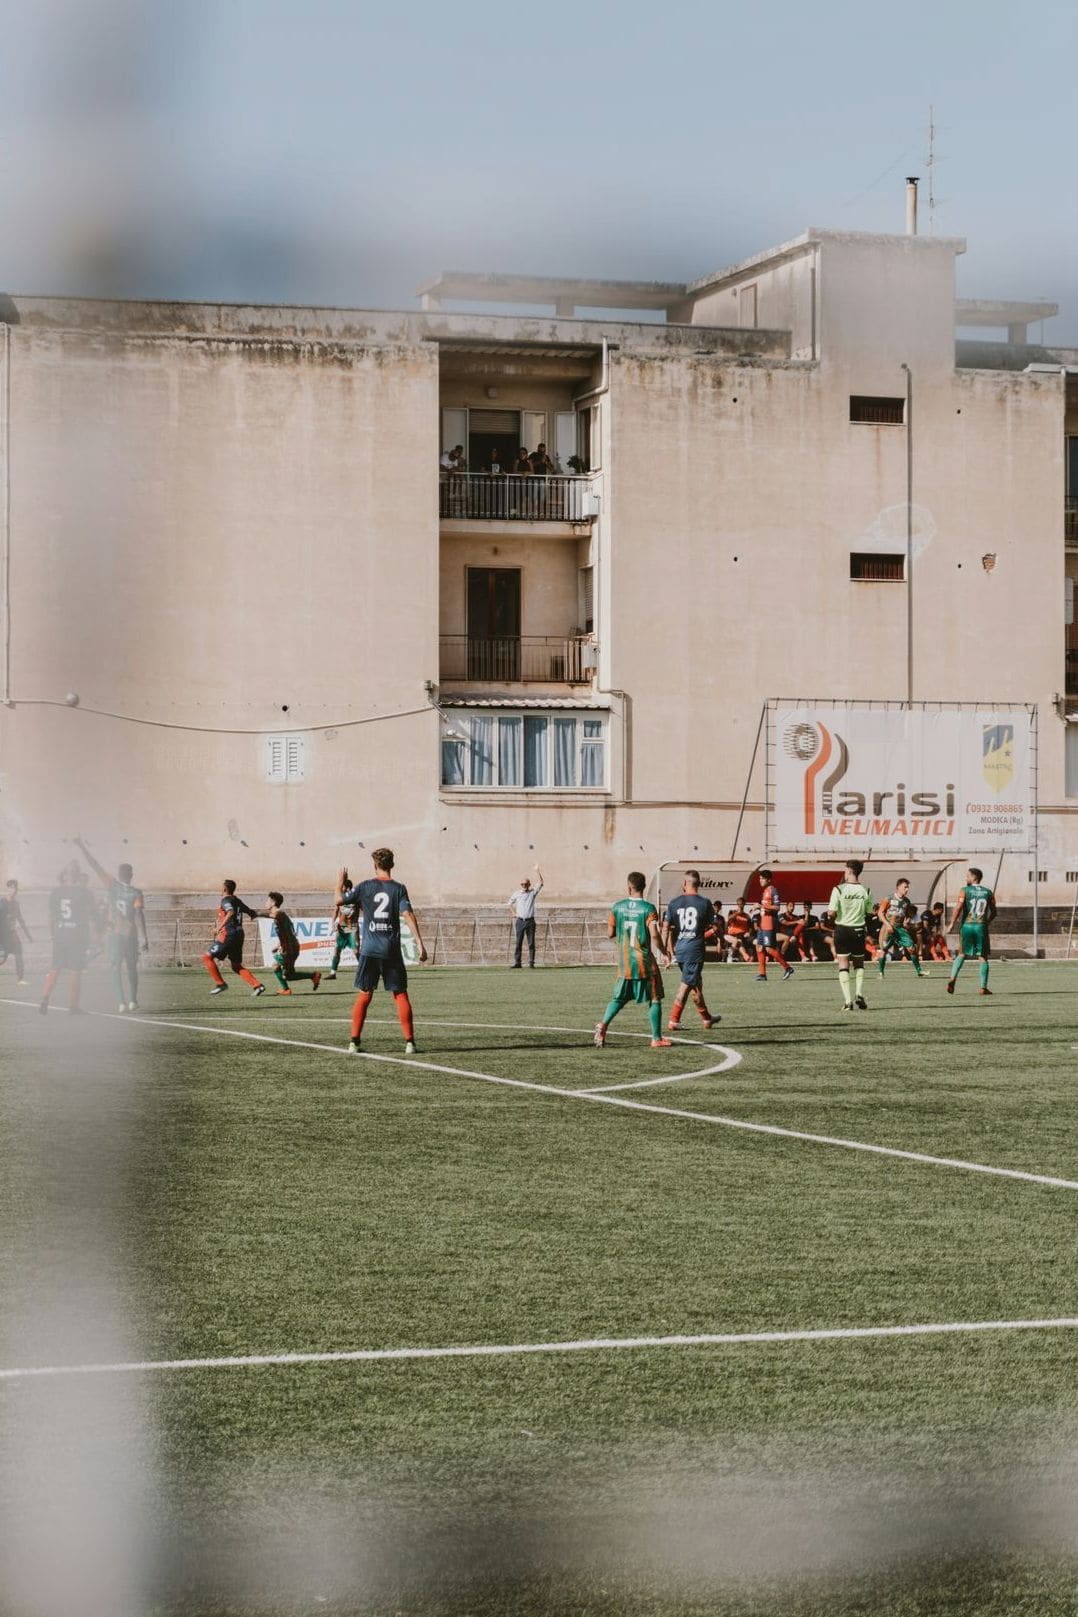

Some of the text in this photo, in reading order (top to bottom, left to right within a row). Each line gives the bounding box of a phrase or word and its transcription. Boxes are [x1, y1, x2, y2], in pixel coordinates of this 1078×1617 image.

[980, 815, 1009, 824] MODICA
[60, 899, 72, 919] 5
[373, 892, 390, 919] 2
[970, 898, 988, 919] 10
[676, 906, 698, 931] 18
[623, 920, 638, 947] 7
